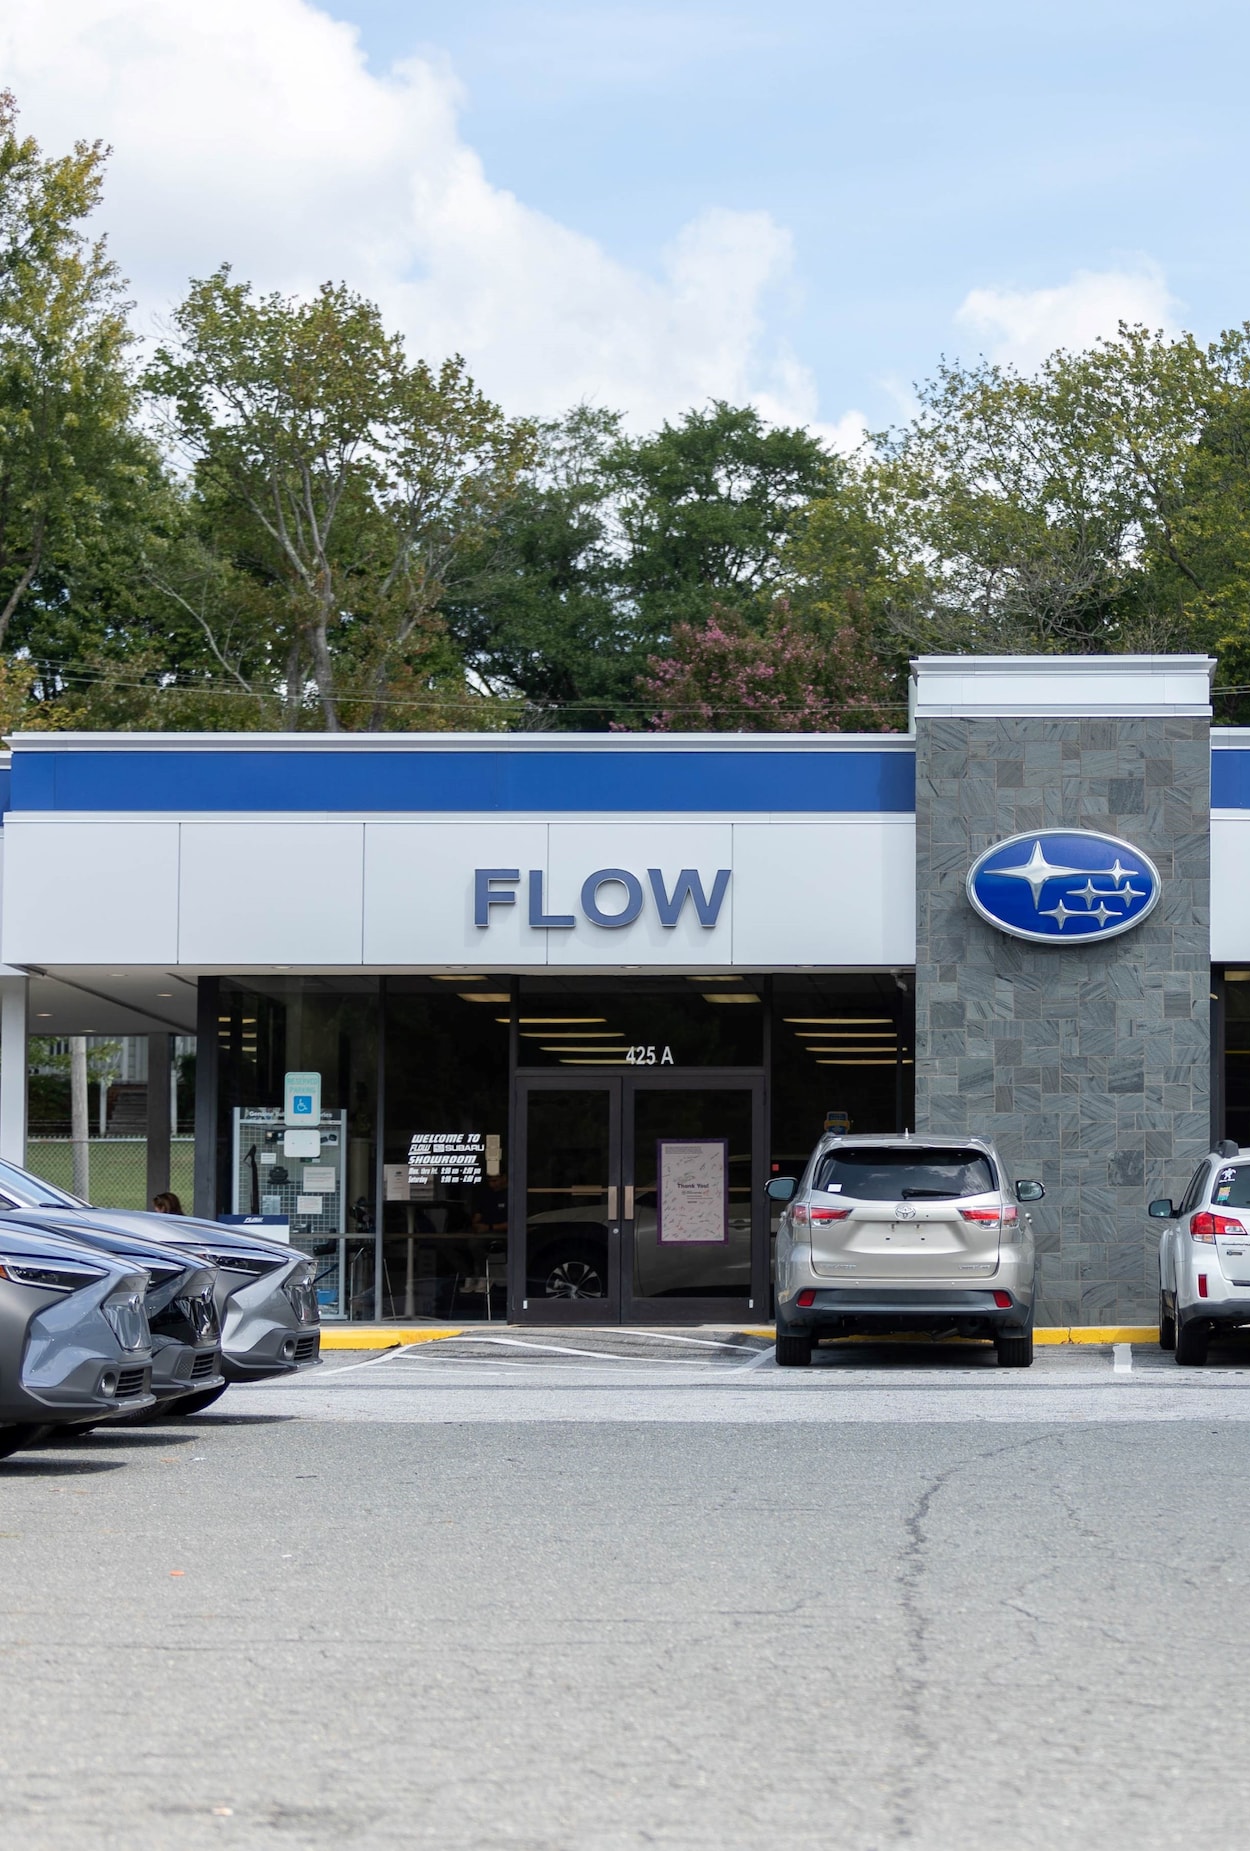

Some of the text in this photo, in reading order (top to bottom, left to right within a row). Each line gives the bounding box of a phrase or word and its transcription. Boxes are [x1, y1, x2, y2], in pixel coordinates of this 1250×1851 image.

[474, 868, 732, 928] FLOW
[626, 1046, 674, 1065] 425 A
[411, 1134, 481, 1143] WELCOME TO
[409, 1144, 485, 1152] FLOW SUBARU
[408, 1155, 477, 1164] SHOWROOM
